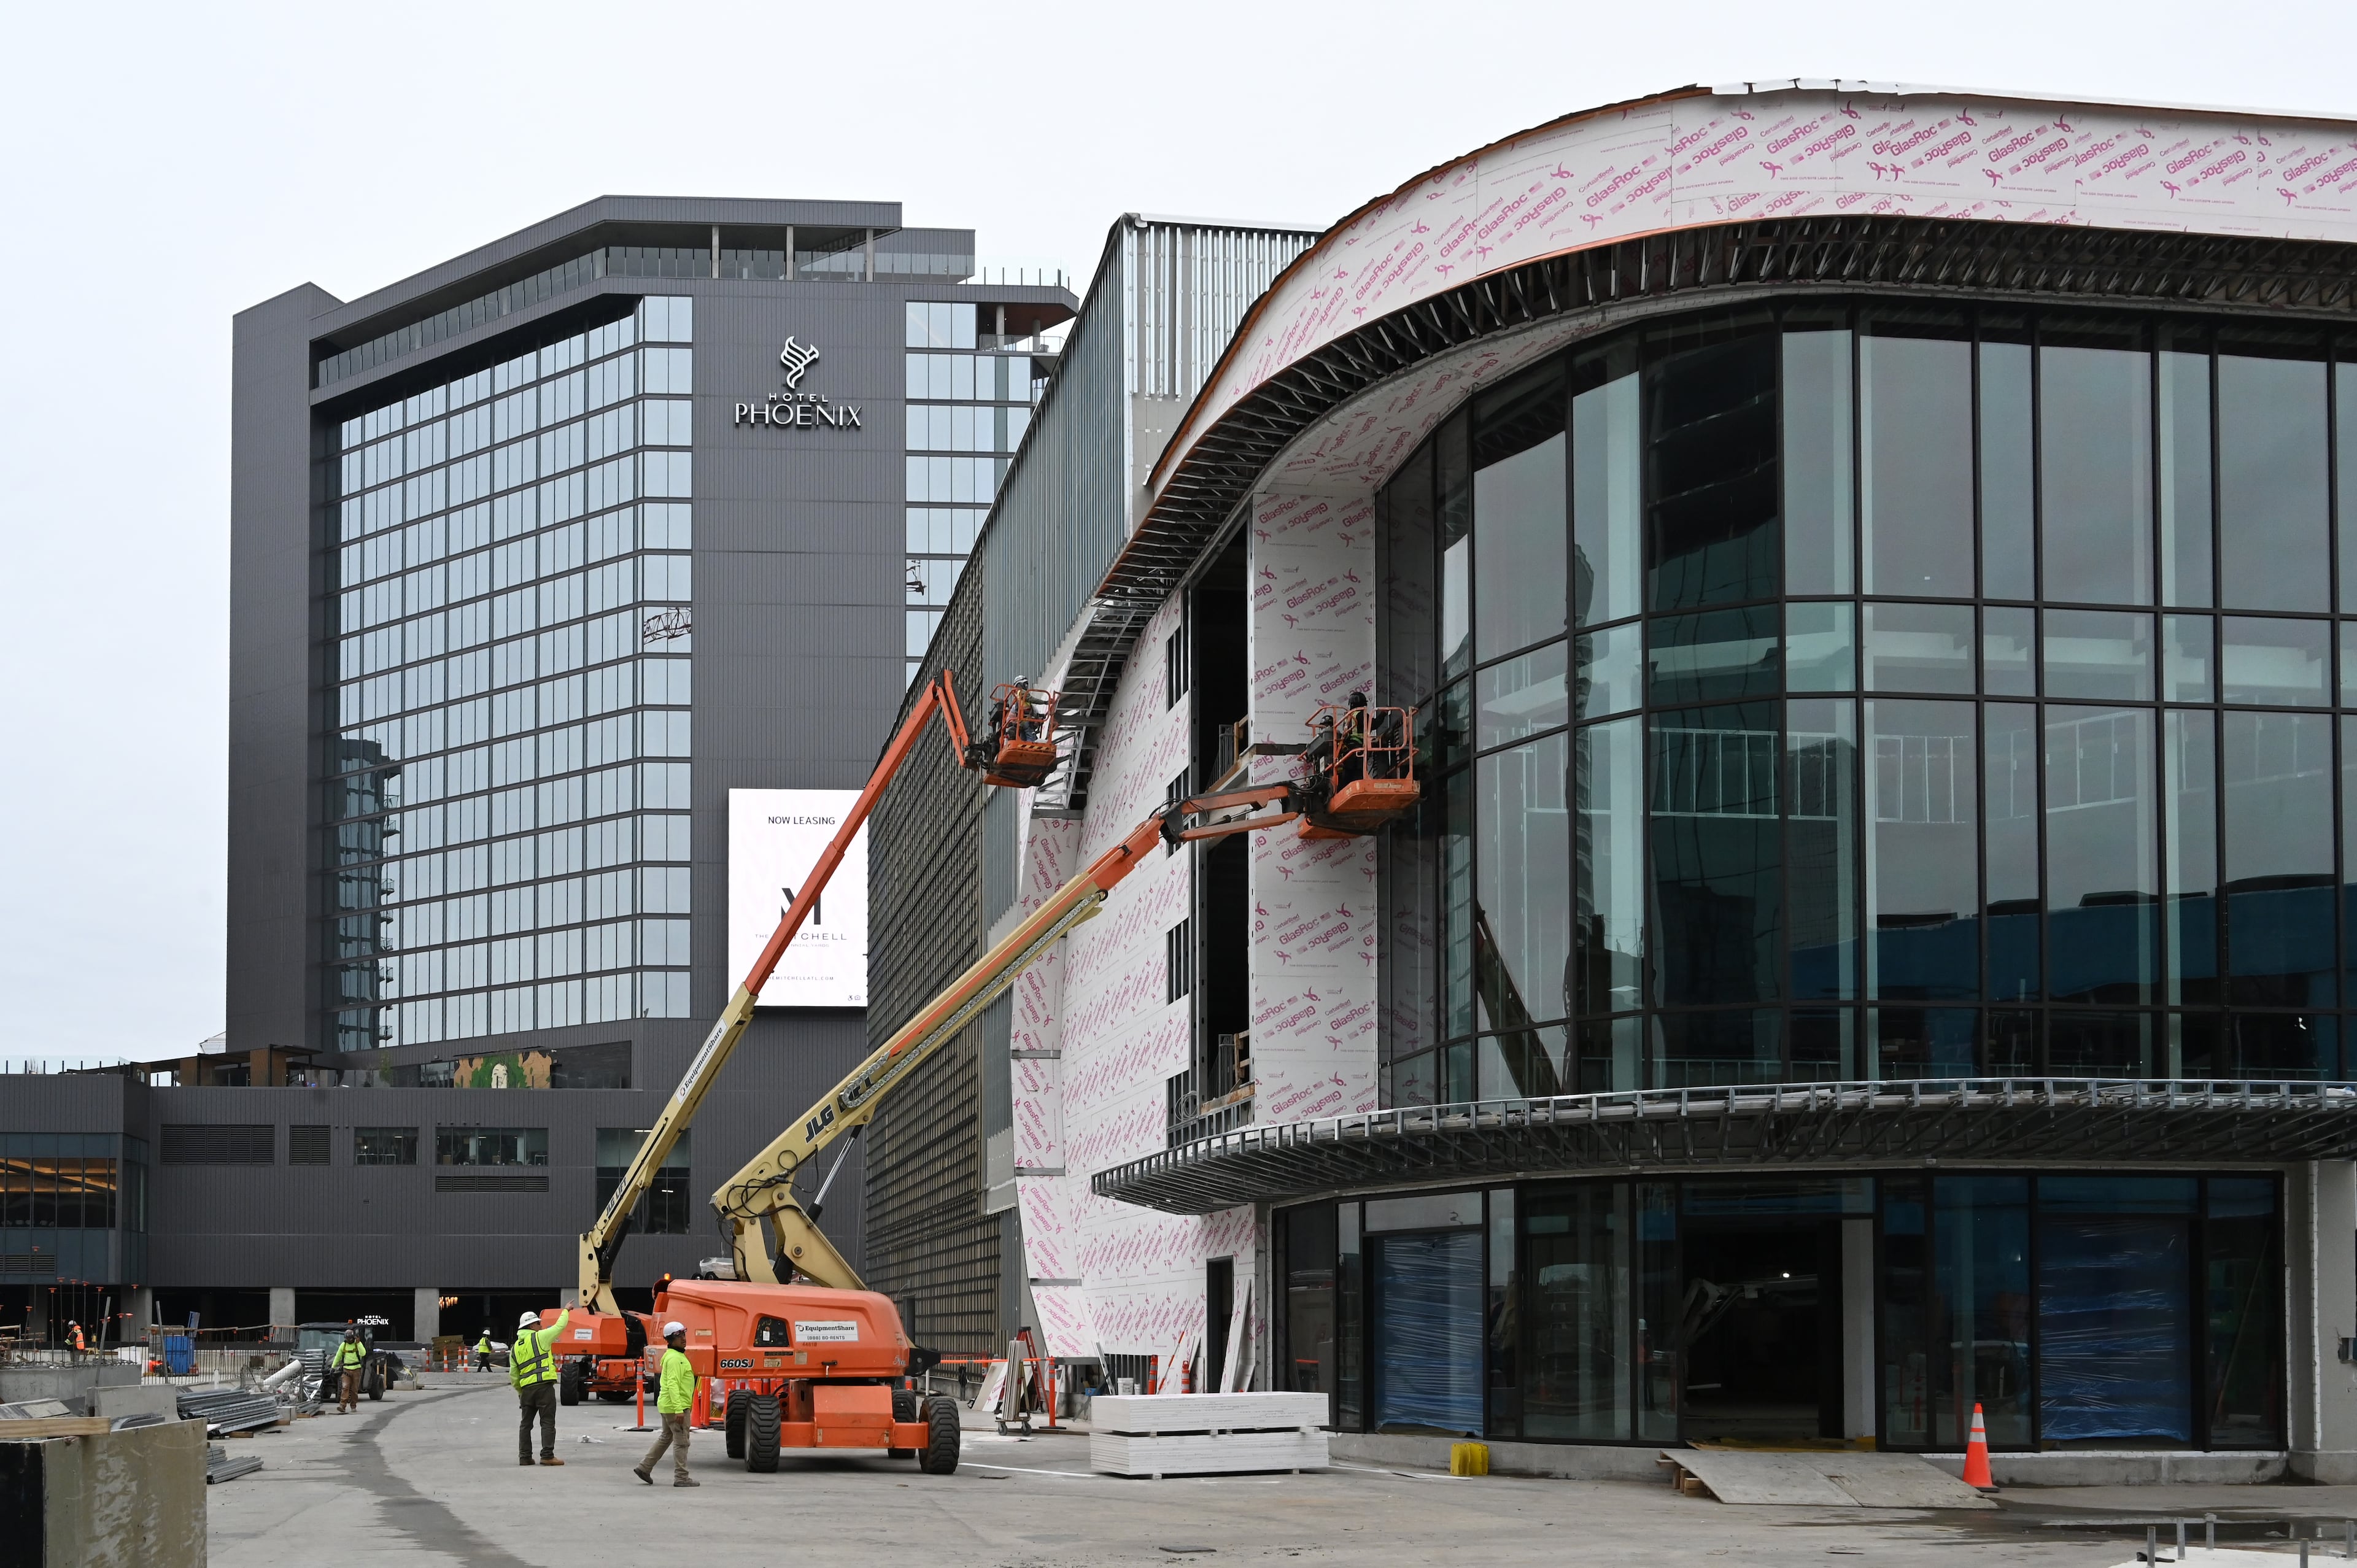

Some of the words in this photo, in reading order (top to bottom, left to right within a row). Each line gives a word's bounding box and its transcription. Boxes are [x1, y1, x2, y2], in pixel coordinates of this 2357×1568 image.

[1692, 126, 1747, 164] GlasRoc
[1767, 121, 1819, 154] GlasRoc
[1805, 125, 1856, 156] GlasRoc
[1891, 126, 1937, 156] GlasRoc
[1925, 131, 1972, 161] GlasRoc
[1988, 132, 2034, 162] GlasRoc
[2022, 137, 2068, 168] GlasRoc
[2103, 144, 2148, 173] GlasRoc
[2166, 145, 2212, 174] GlasRoc
[2200, 150, 2246, 180] GlasRoc
[2283, 153, 2328, 182] GlasRoc
[1587, 166, 1641, 207] GlasRoc
[1478, 194, 1528, 239] GlasRoc
[1514, 187, 1566, 230] GlasRoc
[1356, 253, 1393, 300] GlasRoc
[1382, 241, 1423, 288] GlasRoc
[769, 393, 828, 402] HOTEL
[735, 403, 862, 426] PHOENIX
[1259, 498, 1299, 524] GlasRoc
[1288, 502, 1328, 527] GlasRoc
[1287, 583, 1326, 609] GlasRoc
[1316, 587, 1356, 612] GlasRoc
[1265, 668, 1306, 695] GlasRoc
[1320, 668, 1360, 694] GlasRoc
[793, 816, 835, 825] LEASING
[1040, 838, 1056, 868] GlasRoc
[1037, 859, 1052, 889] GlasRoc
[1279, 919, 1319, 945] GlasRoc
[1309, 922, 1349, 948] GlasRoc
[1026, 971, 1043, 1002] GlasRoc
[1023, 994, 1040, 1023] GlasRoc
[1275, 1005, 1316, 1032] GlasRoc
[1330, 1004, 1371, 1030] GlasRoc
[685, 1027, 722, 1089] EquipmentShare
[1272, 1087, 1312, 1114] GlasRoc
[1301, 1091, 1342, 1117] GlasRoc
[805, 1103, 835, 1143] JLG
[1024, 1101, 1043, 1129] GlasRoc
[1023, 1121, 1042, 1149] GlasRoc
[1031, 1188, 1051, 1213] GlasRoc
[1031, 1206, 1052, 1231] GlasRoc
[1037, 1240, 1059, 1267] GlasRoc
[1045, 1295, 1069, 1314] GlasRoc
[1047, 1308, 1070, 1328] GlasRoc
[1058, 1335, 1082, 1355] GlasRoc
[720, 1359, 754, 1368] 660SJ
